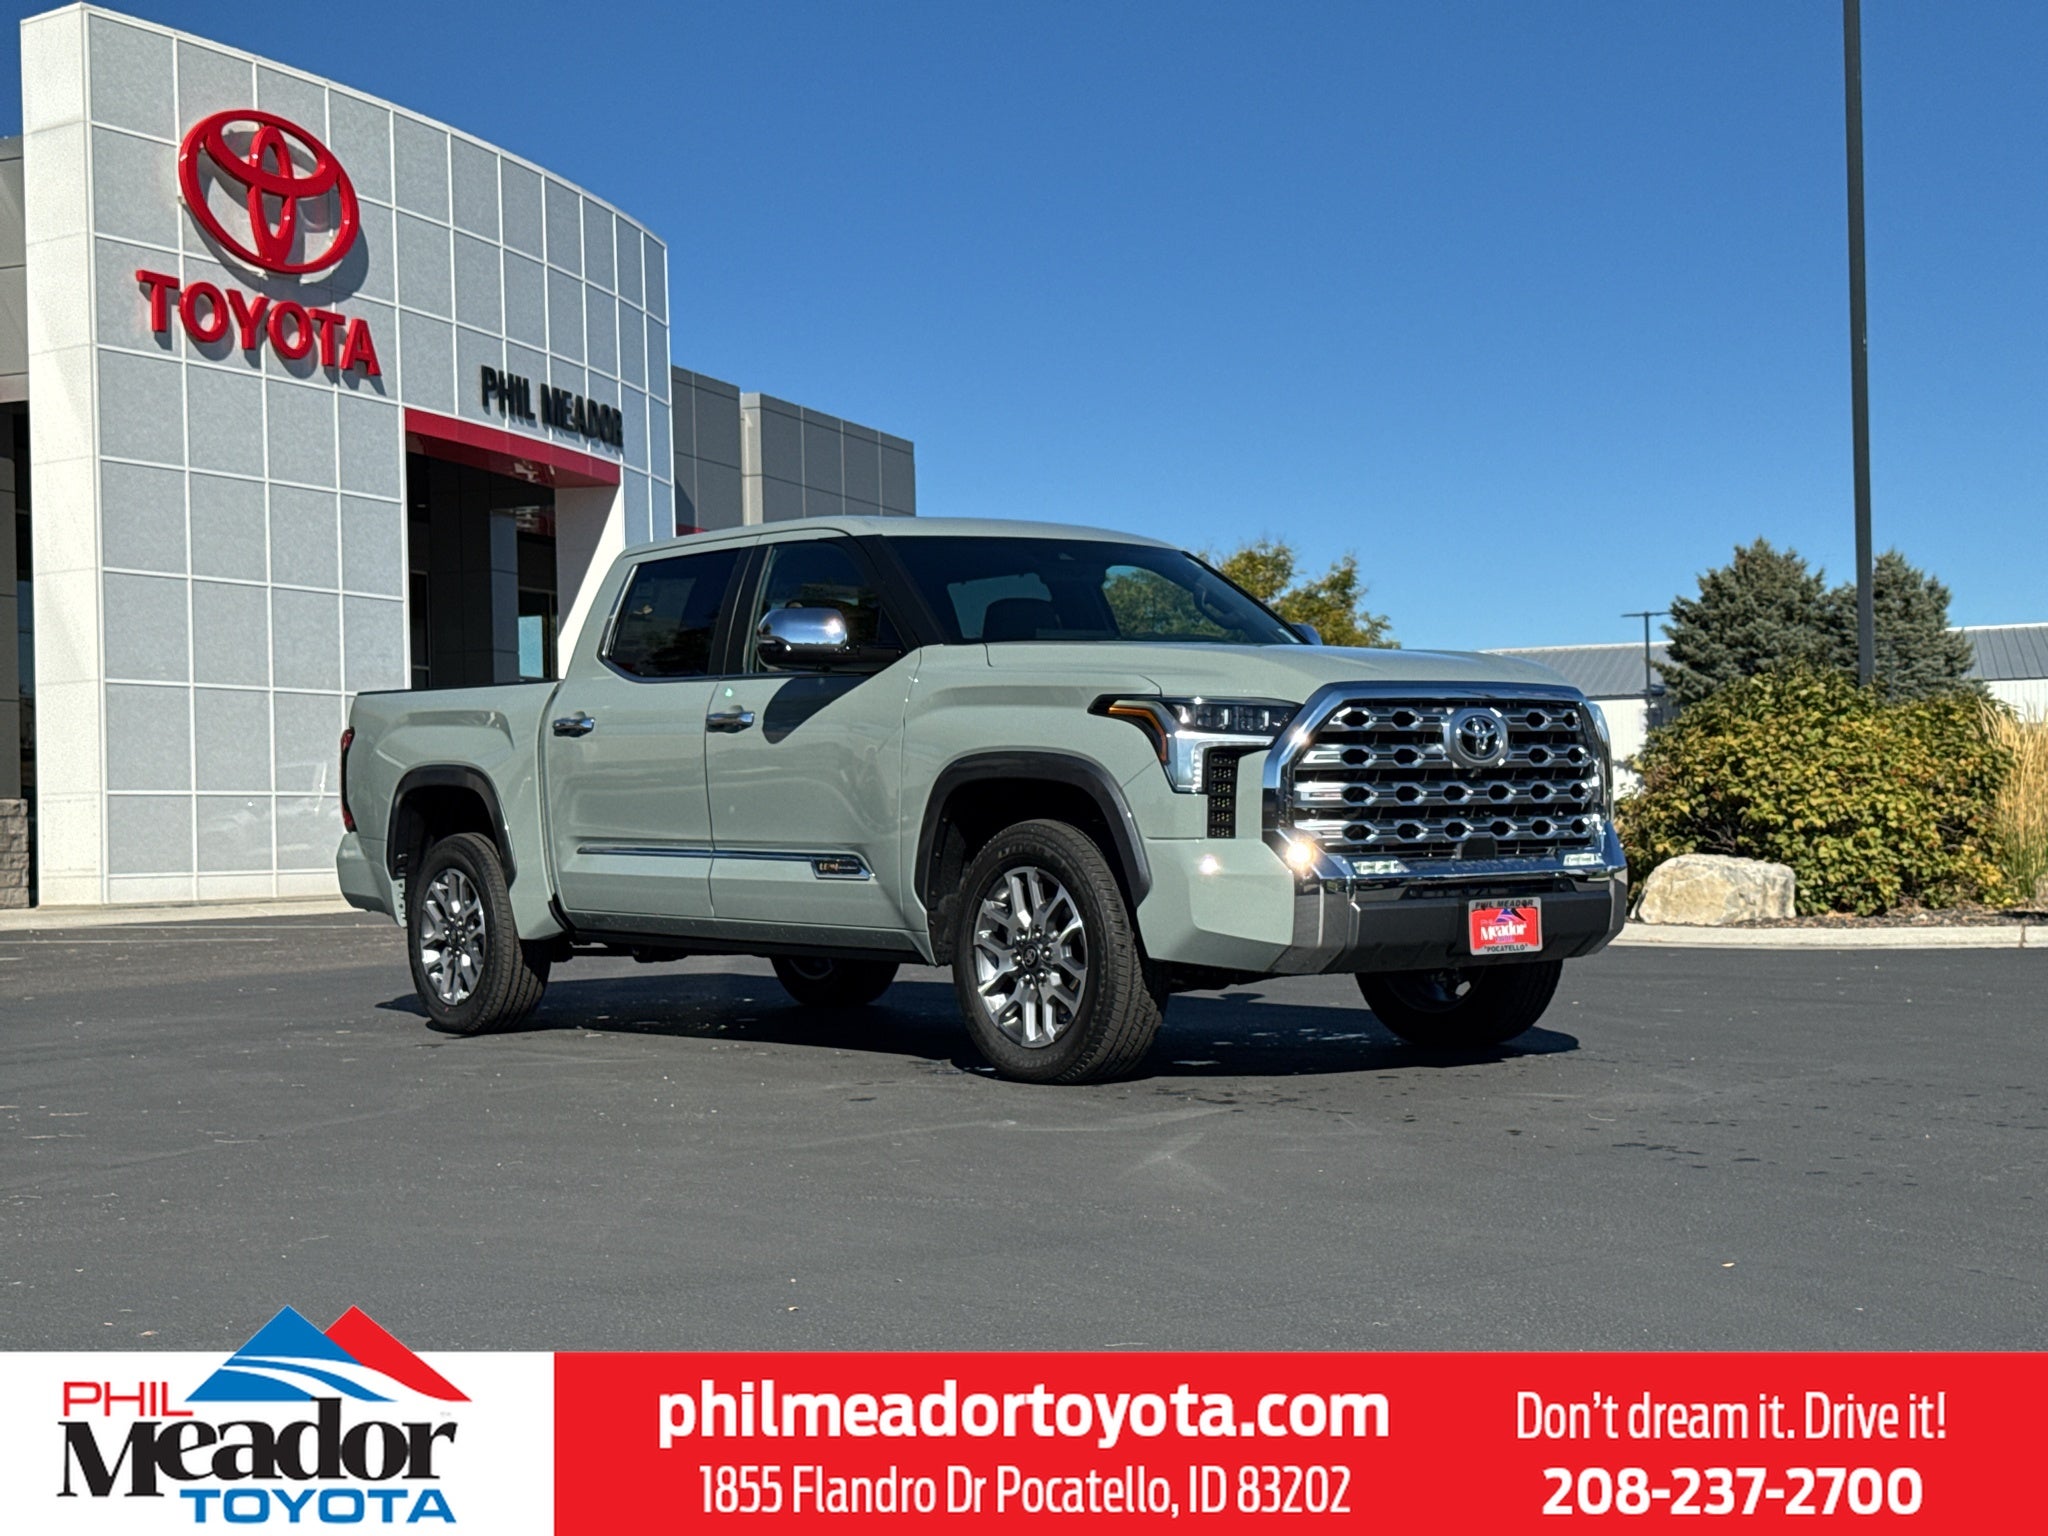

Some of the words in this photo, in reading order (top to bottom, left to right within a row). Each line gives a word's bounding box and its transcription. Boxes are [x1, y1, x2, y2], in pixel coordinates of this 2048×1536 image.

[136, 270, 381, 376] TOYOTA
[481, 365, 536, 421] PHIL
[540, 383, 624, 448] MEADOR
[1480, 920, 1527, 940] Meador
